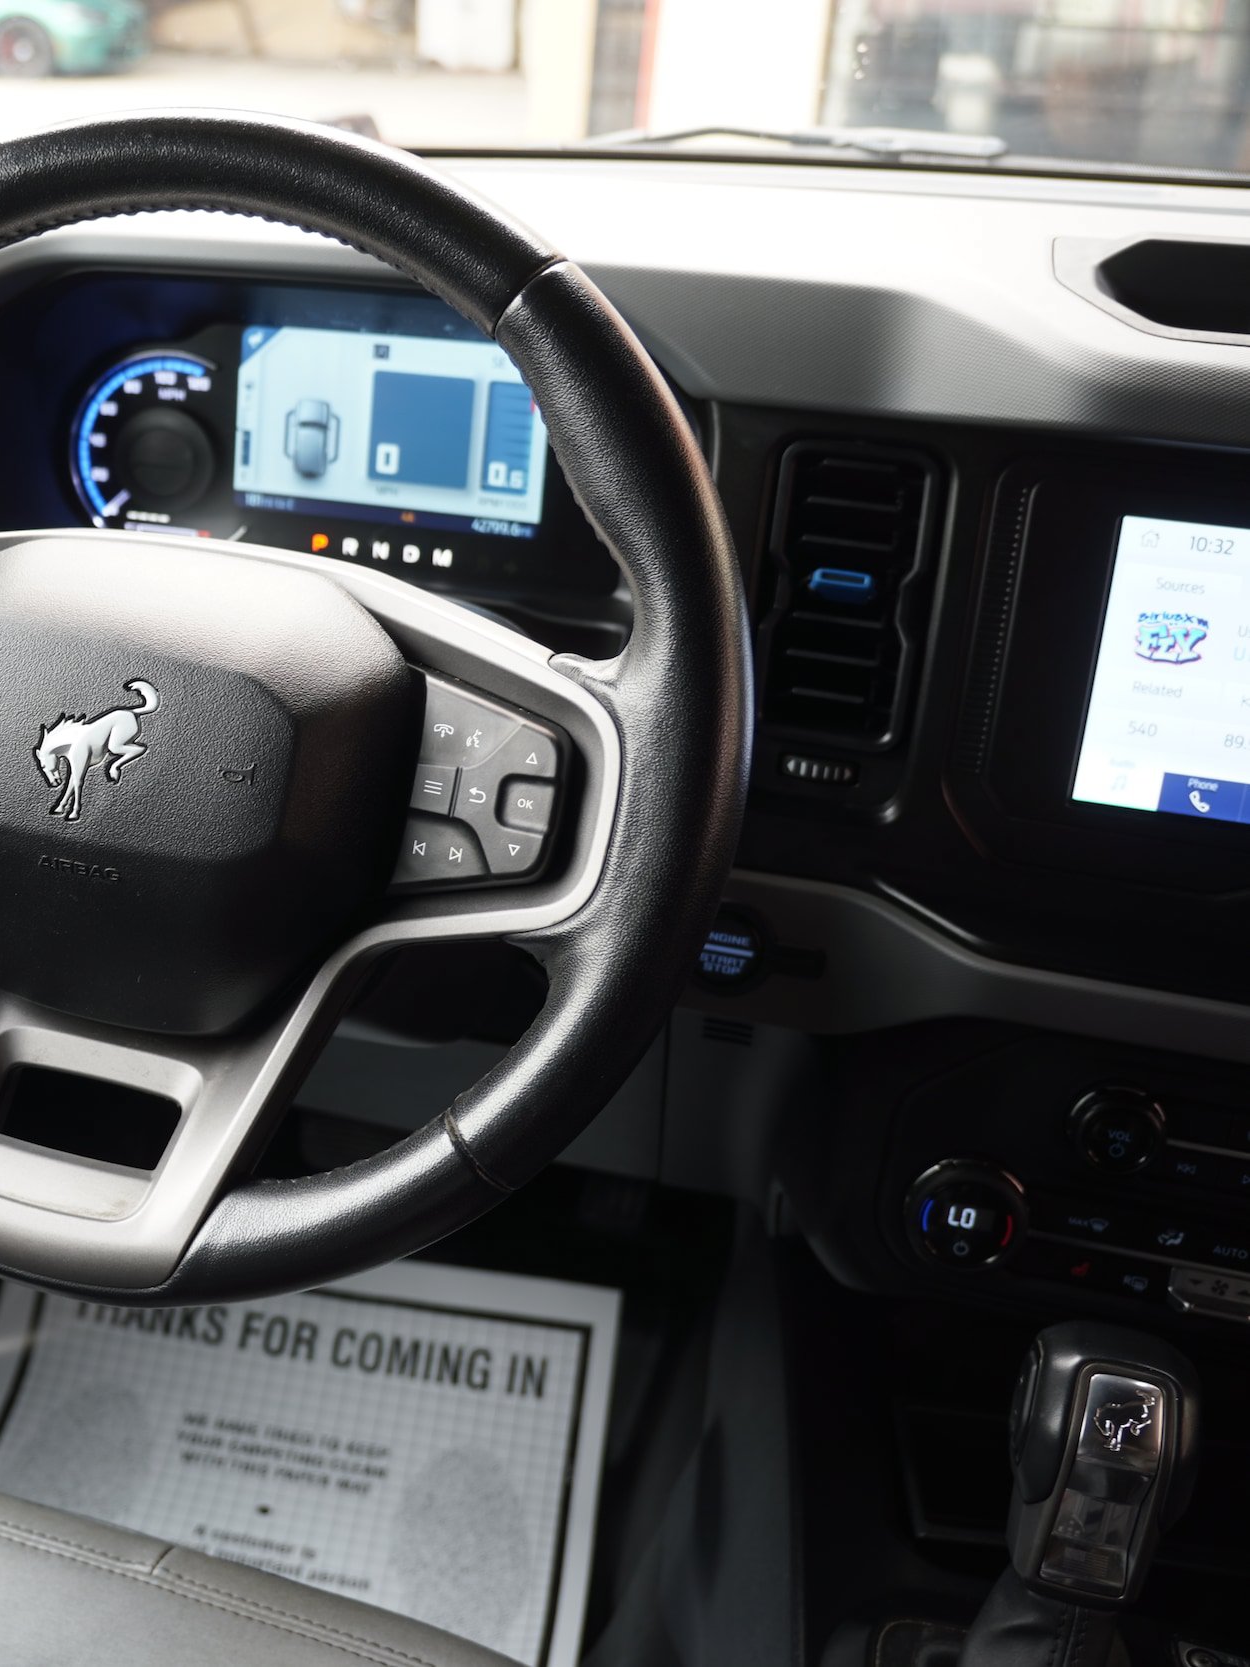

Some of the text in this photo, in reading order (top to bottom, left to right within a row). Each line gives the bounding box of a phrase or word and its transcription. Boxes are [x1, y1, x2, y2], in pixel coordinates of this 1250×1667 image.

[311, 533, 453, 567] P R N D M
[1189, 535, 1235, 556] 10:32
[1155, 577, 1206, 595] Sources
[1132, 681, 1184, 700] Related
[1127, 720, 1158, 738] 540
[1187, 777, 1219, 792] Phone
[517, 798, 534, 810] OK
[38, 855, 121, 882] AIRBAG
[707, 931, 751, 946] NGINE
[1107, 1129, 1133, 1143] VOL
[947, 1205, 977, 1230] LO
[1212, 1244, 1249, 1261] AUTO
[238, 1311, 320, 1361] FOR
[330, 1326, 492, 1392] COMING
[506, 1354, 549, 1400] IN
